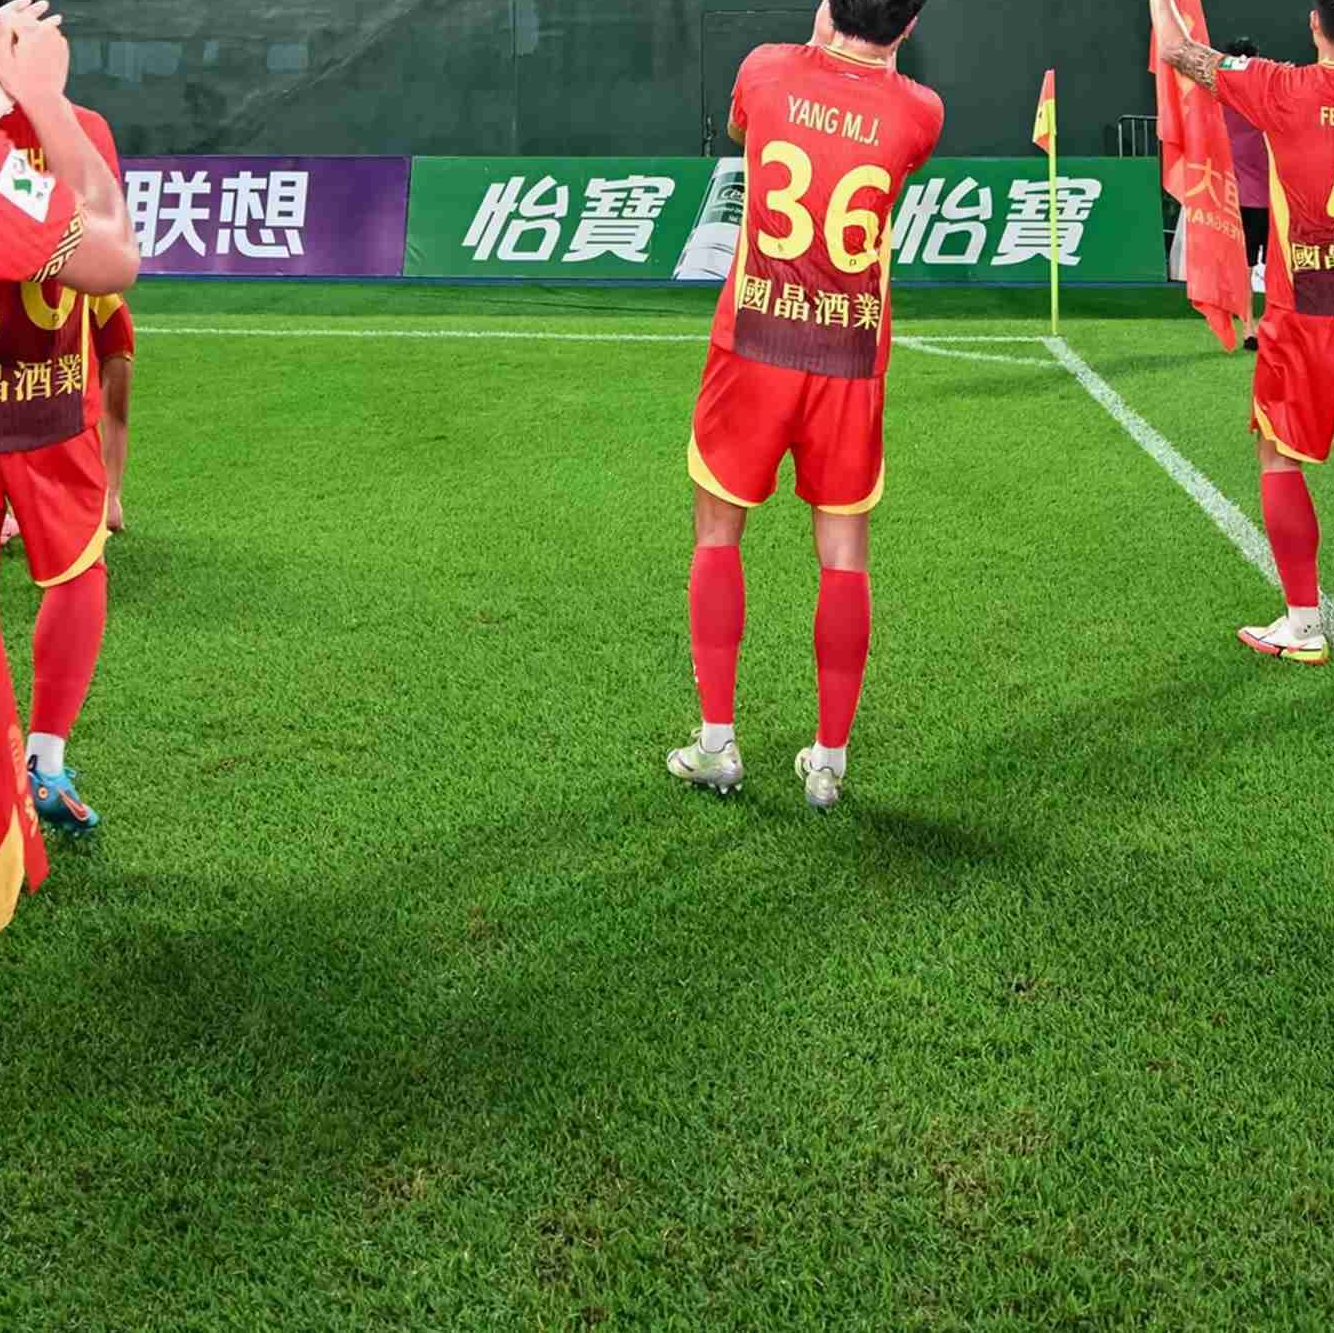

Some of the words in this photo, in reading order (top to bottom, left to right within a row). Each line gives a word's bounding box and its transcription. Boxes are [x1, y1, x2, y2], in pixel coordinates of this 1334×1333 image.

[786, 95, 838, 134] YANG
[841, 112, 880, 146] M.J.
[125, 167, 310, 259] 联想
[461, 173, 675, 264] 怡寶
[757, 140, 892, 274] 36
[891, 174, 1103, 268] 怡寶
